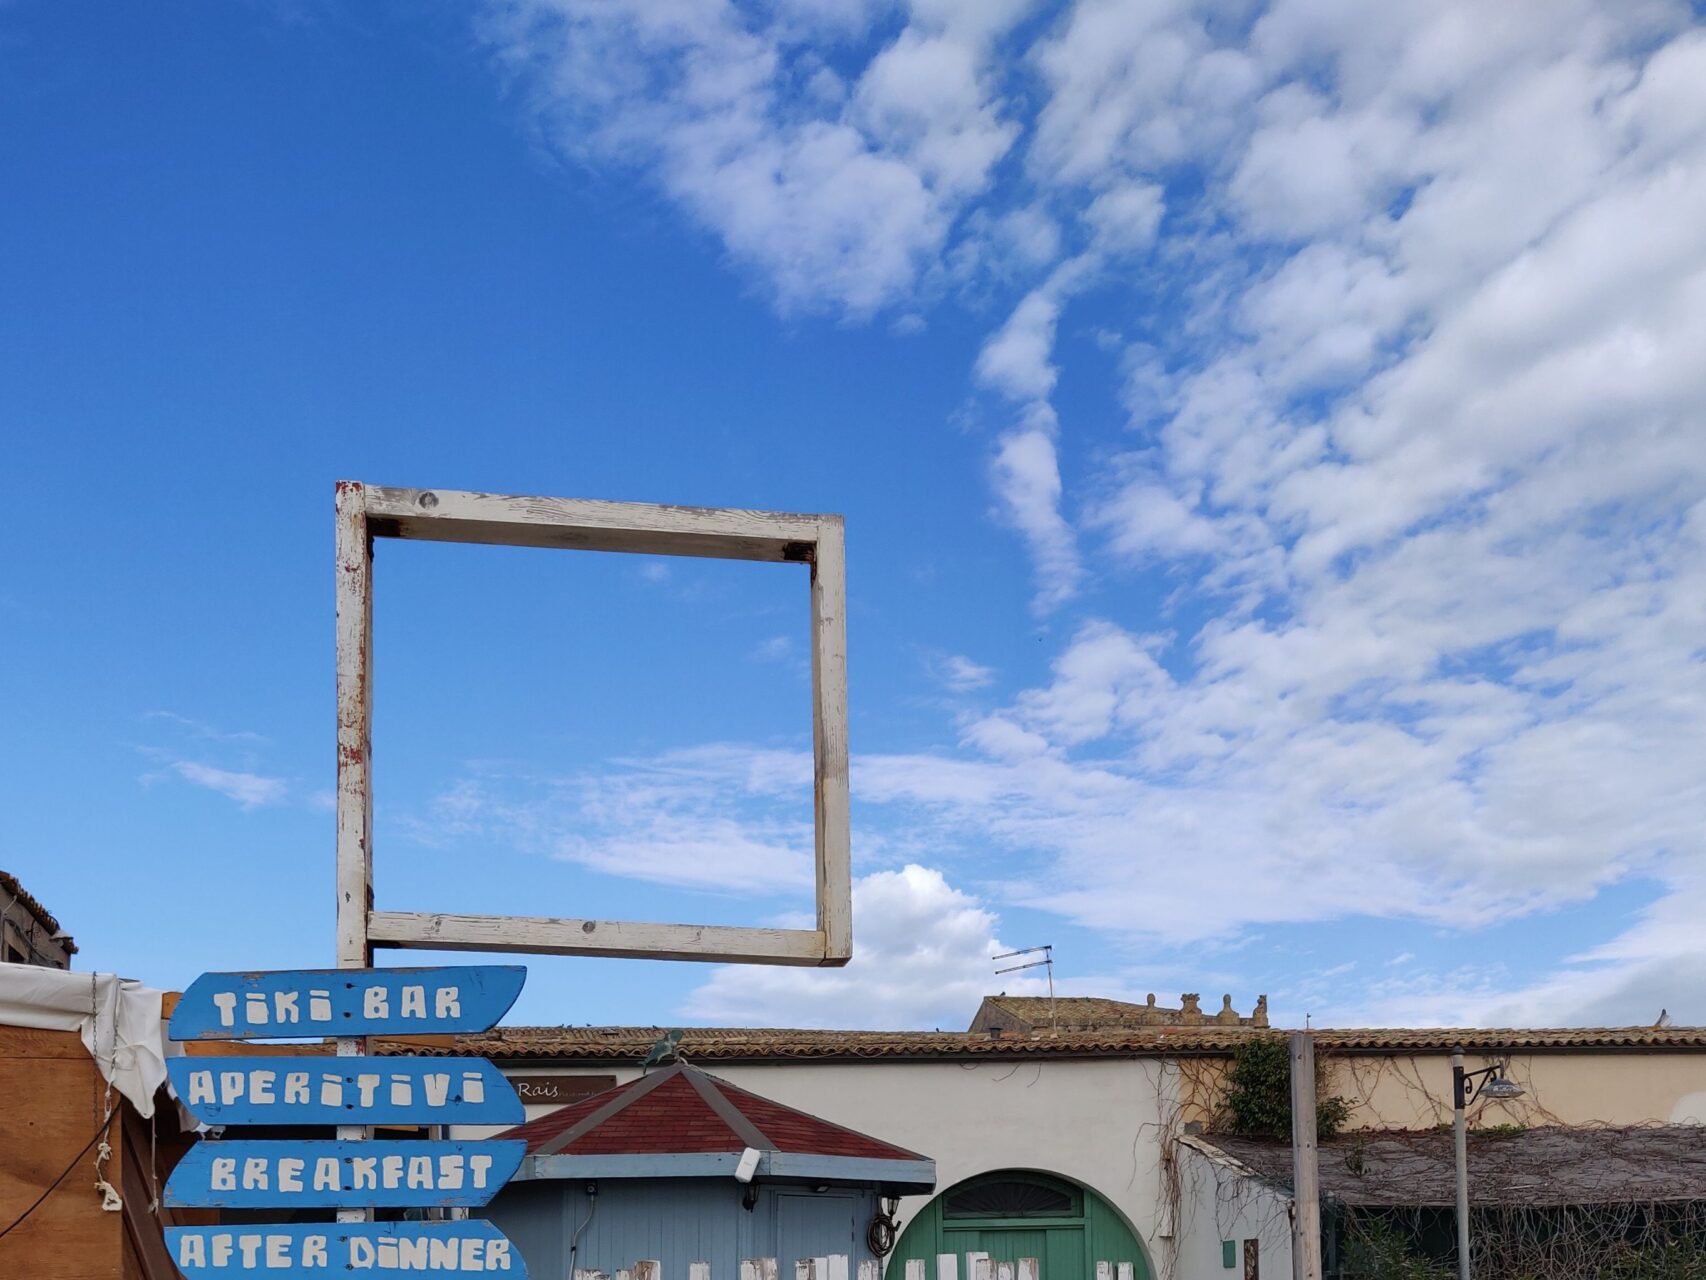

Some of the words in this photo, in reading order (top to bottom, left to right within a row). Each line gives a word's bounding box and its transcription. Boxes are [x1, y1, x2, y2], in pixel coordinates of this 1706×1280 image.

[363, 985, 461, 1019] BAR
[517, 1081, 560, 1098] Rais
[211, 1154, 493, 1193] BREAKFAST
[179, 1233, 328, 1269] AFTER
